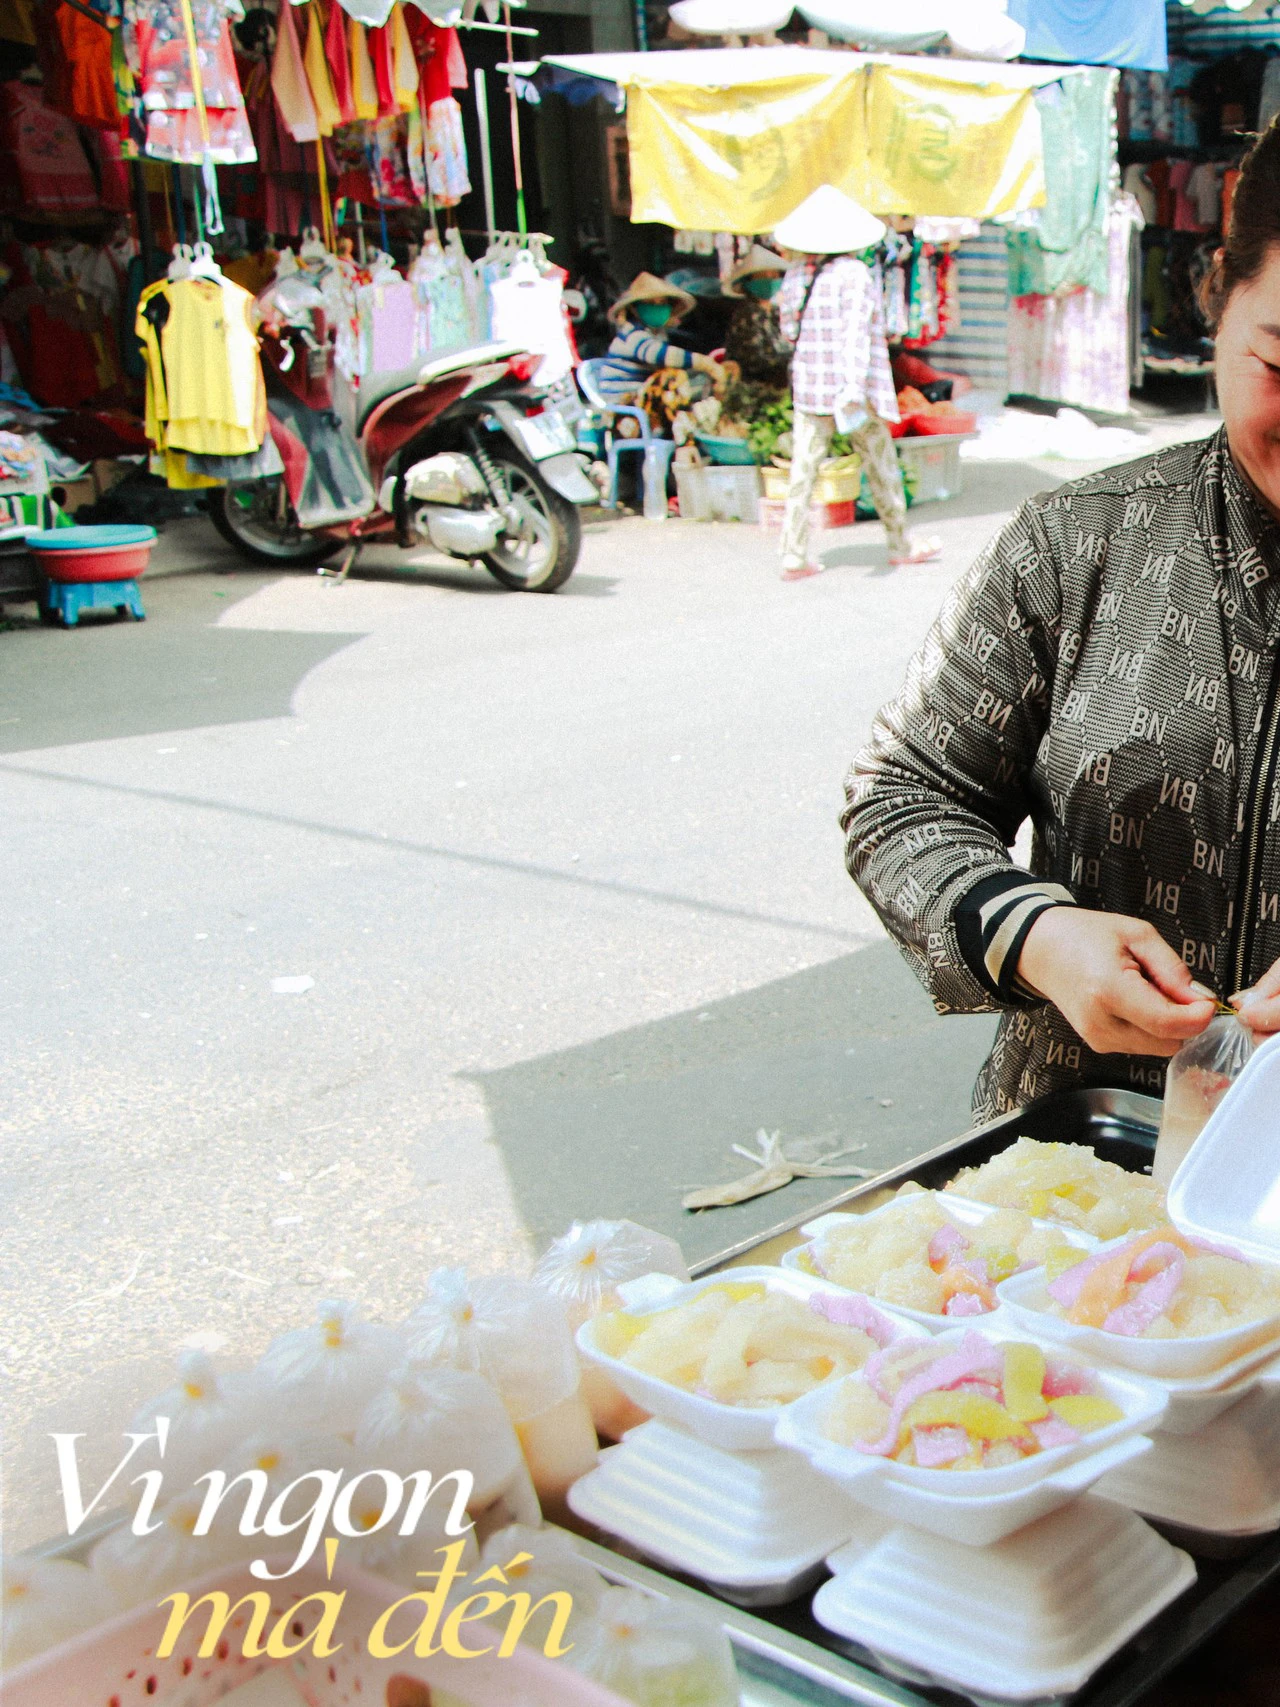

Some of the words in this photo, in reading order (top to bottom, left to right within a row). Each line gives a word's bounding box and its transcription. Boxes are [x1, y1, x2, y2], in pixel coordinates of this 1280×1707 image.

[1123, 501, 1157, 530] BN
[1160, 607, 1197, 647] BN
[1229, 643, 1261, 682] BN
[1130, 705, 1169, 746] BN
[1109, 813, 1145, 849] BN
[1193, 838, 1225, 878] BN
[1182, 938, 1216, 973] BN
